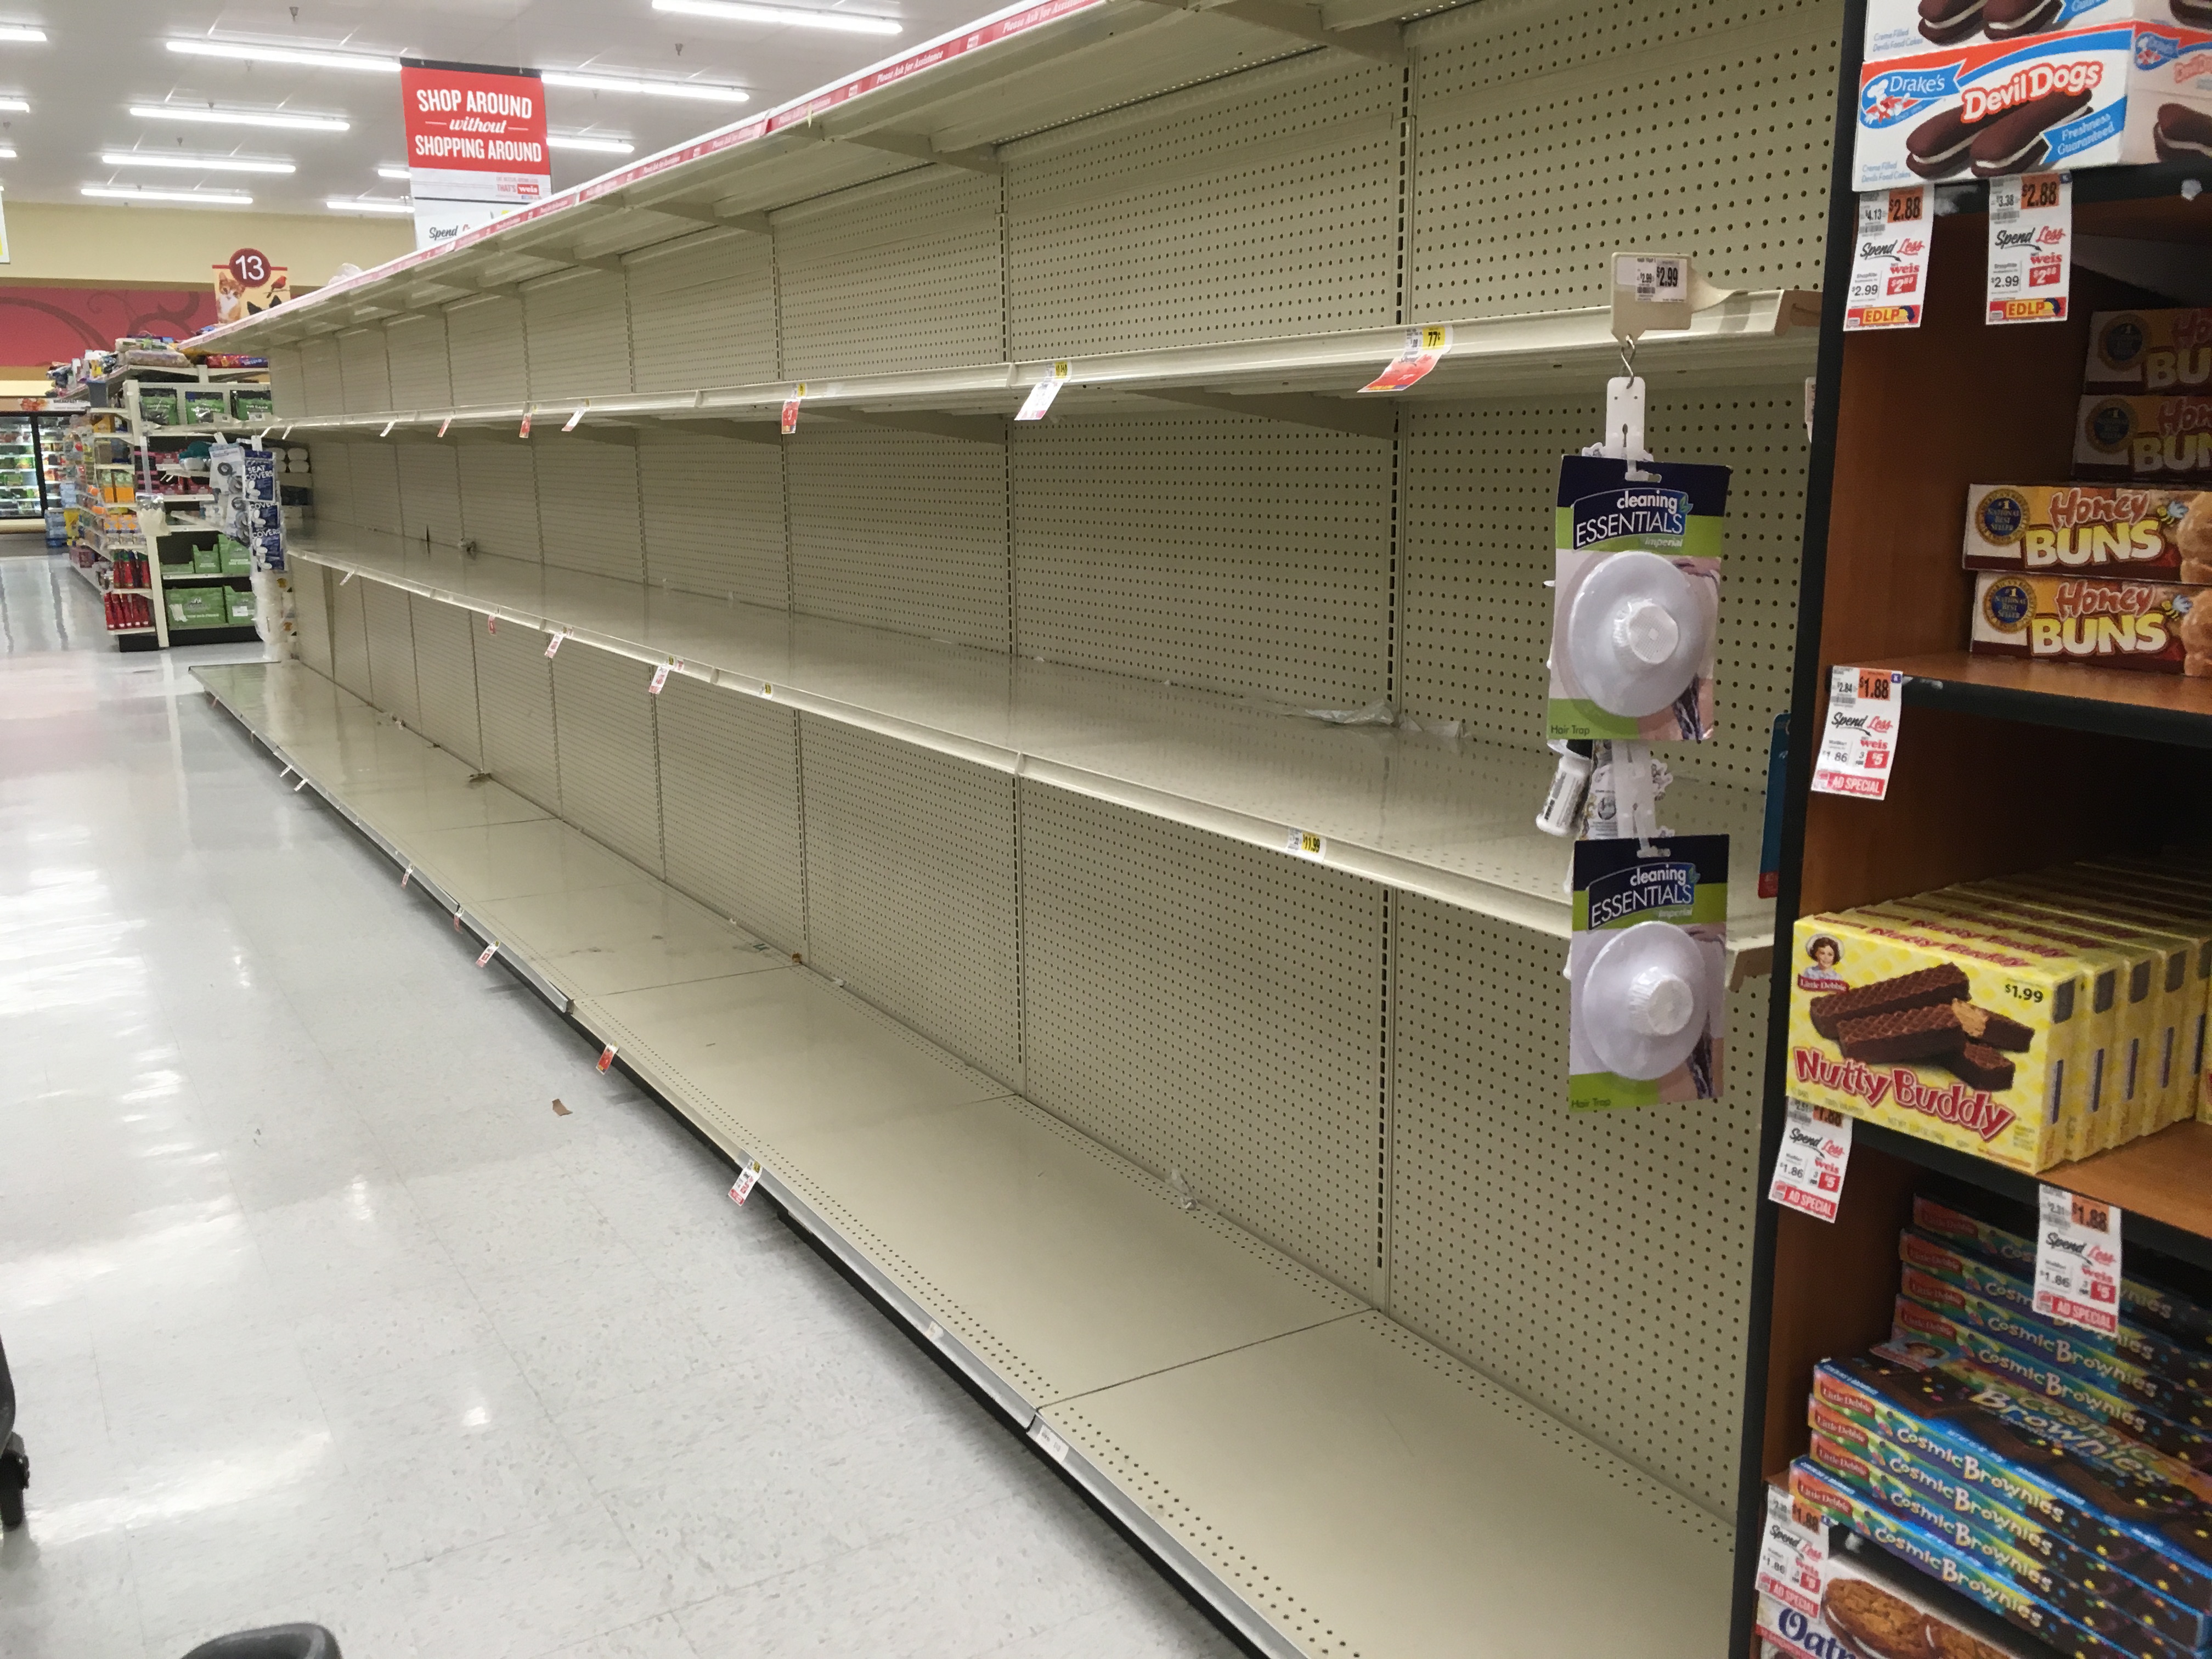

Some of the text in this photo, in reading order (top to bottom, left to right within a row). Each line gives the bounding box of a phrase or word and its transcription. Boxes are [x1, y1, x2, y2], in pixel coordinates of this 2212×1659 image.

[1890, 74, 1945, 93] Drake's
[1962, 72, 2027, 121] Devil
[2028, 63, 2101, 99] Dogs
[417, 89, 532, 119] SHOP AROUND
[449, 116, 507, 133] without
[2062, 113, 2111, 140] Freshness
[415, 135, 541, 162] SHOPPING AROUND
[2058, 122, 2115, 155] Guaranteed
[2022, 181, 2057, 207] $2.88
[1889, 196, 1921, 221] $2.88
[428, 225, 458, 241] Spend
[1995, 225, 2066, 250] Spend Less
[1860, 238, 1925, 261] Spend Less
[2030, 252, 2062, 265] weis
[235, 255, 265, 282] 13
[1656, 266, 1678, 287] $2.99
[1890, 263, 1920, 275] weis
[1852, 284, 1878, 297] $2.99
[1991, 275, 2019, 288] $2.99
[1865, 308, 1900, 323] EDLP
[2008, 301, 2045, 317] EDLP
[2146, 347, 2212, 388] BU
[2156, 396, 2212, 436] Hon
[245, 470, 274, 481] COVERS
[247, 465, 266, 474] SEAT
[1617, 490, 1677, 514] cleaning
[2048, 487, 2151, 532] Honey
[252, 528, 281, 539] COVERS
[1576, 511, 1683, 548] ESSENTIALS
[2024, 518, 2164, 566] BUNS
[2054, 579, 2155, 621] Honey
[2030, 611, 2168, 655] BUNS
[1859, 676, 1889, 699] $1.88
[1550, 725, 1590, 736] Hair Trap
[1831, 712, 1893, 733] Spend Less
[1860, 739, 1888, 751] weis
[1831, 776, 1880, 793] AD SPECIAL
[1630, 864, 1686, 886] cleaning
[1592, 884, 1692, 928] ESSENTIALS
[1820, 981, 1847, 992] Debbie
[2005, 983, 2044, 1003] $1.99
[1793, 1047, 1892, 1108] Nutty
[1892, 1066, 2016, 1140] Buddy
[1790, 1128, 1823, 1148] Spend
[1780, 1162, 1804, 1178] $1.86
[1815, 1158, 1839, 1174] weis
[1788, 1189, 1832, 1215] AD SPECIAL
[2072, 1201, 2107, 1232] $1.88
[1985, 1282, 2034, 1305] Cosm
[1988, 1317, 2158, 1398] Cosmic Brownies
[1822, 1387, 1872, 1413] Little Debbie
[1978, 1348, 2147, 1433] Cosmic Brownies
[1817, 1413, 1866, 1442] Little Debbie
[1819, 1449, 1867, 1476] Little Debbie
[1897, 1427, 1963, 1469] Cosmic
[1963, 1455, 2064, 1523] Brownies
[1800, 1483, 1849, 1514] Little Debbie
[1889, 1458, 1954, 1499] Cosmic
[1955, 1486, 2053, 1556] Brownies
[1792, 1502, 1819, 1534] $1.88
[1891, 1492, 2053, 1593] Cosmic Brownies
[1875, 1527, 2043, 1628] Cosmic Brownies
